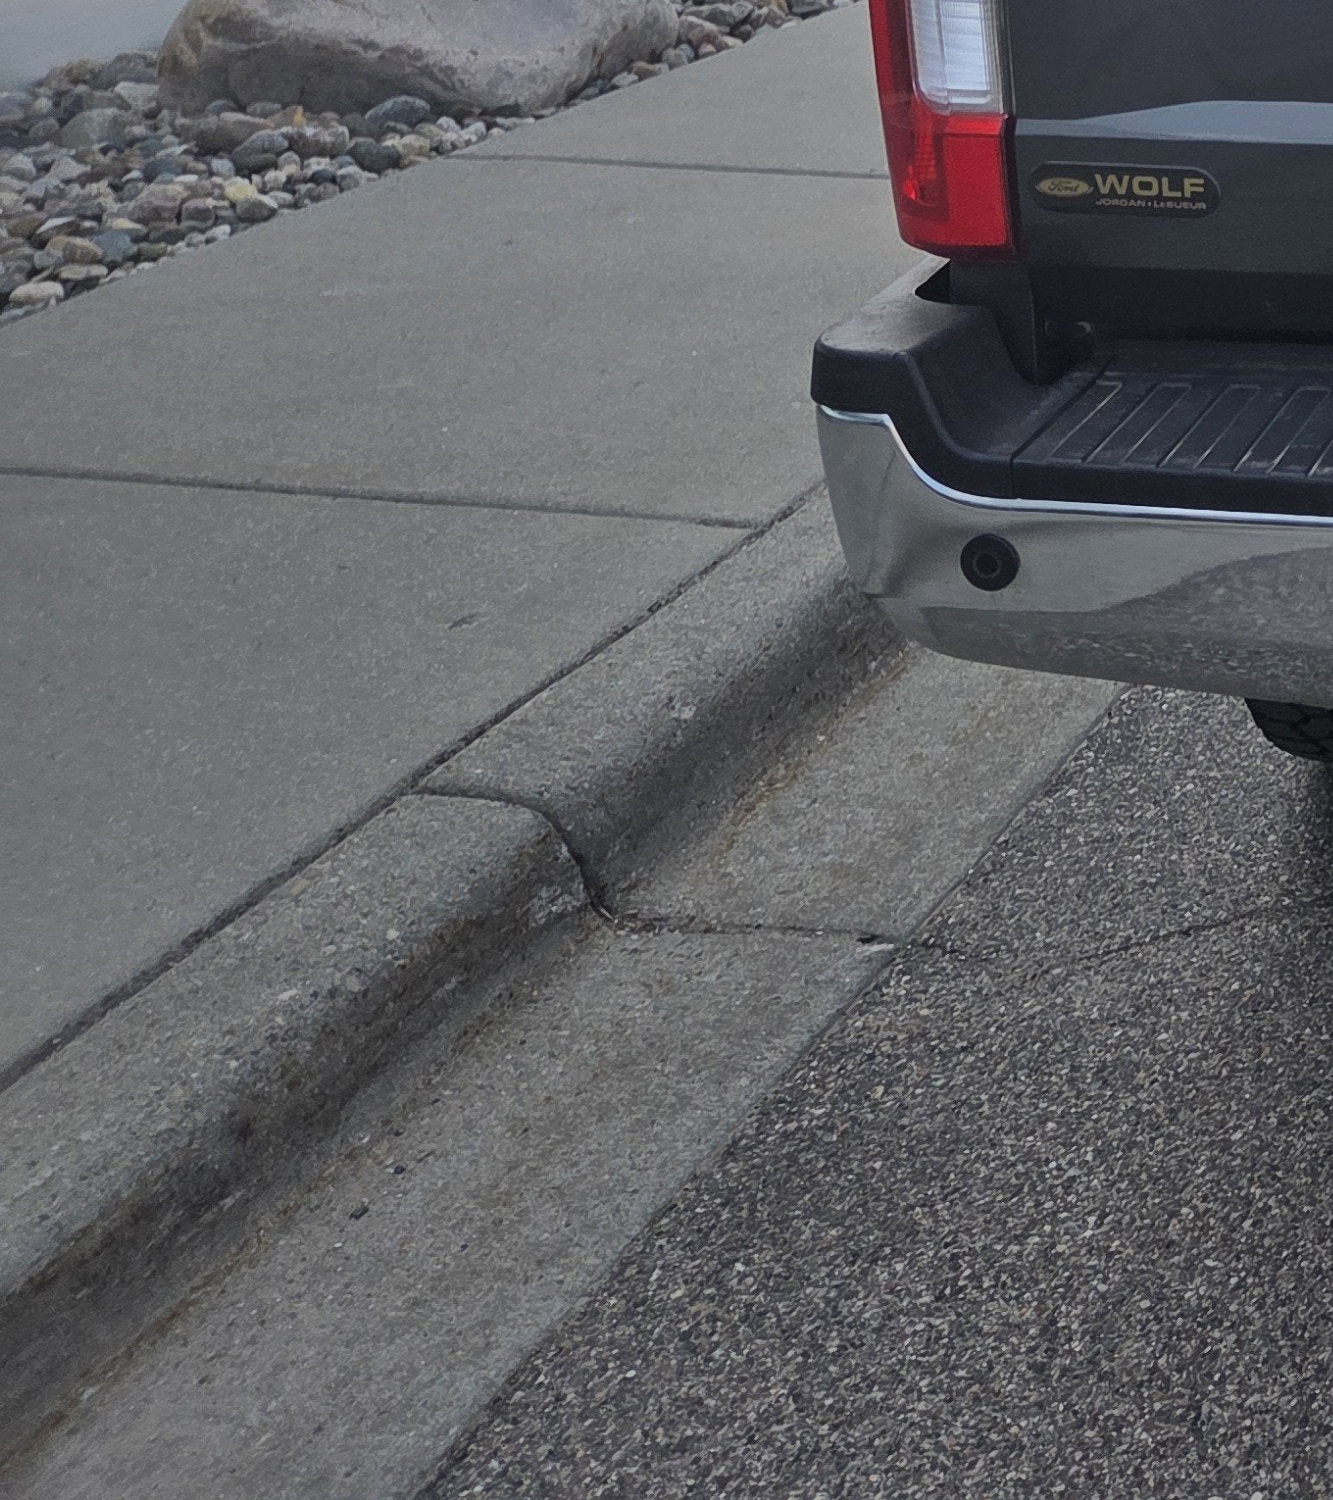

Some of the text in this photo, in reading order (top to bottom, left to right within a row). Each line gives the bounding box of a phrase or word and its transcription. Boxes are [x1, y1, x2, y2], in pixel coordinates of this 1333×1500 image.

[1047, 173, 1205, 198] Ford WOLF
[1095, 197, 1146, 208] JORDAN
